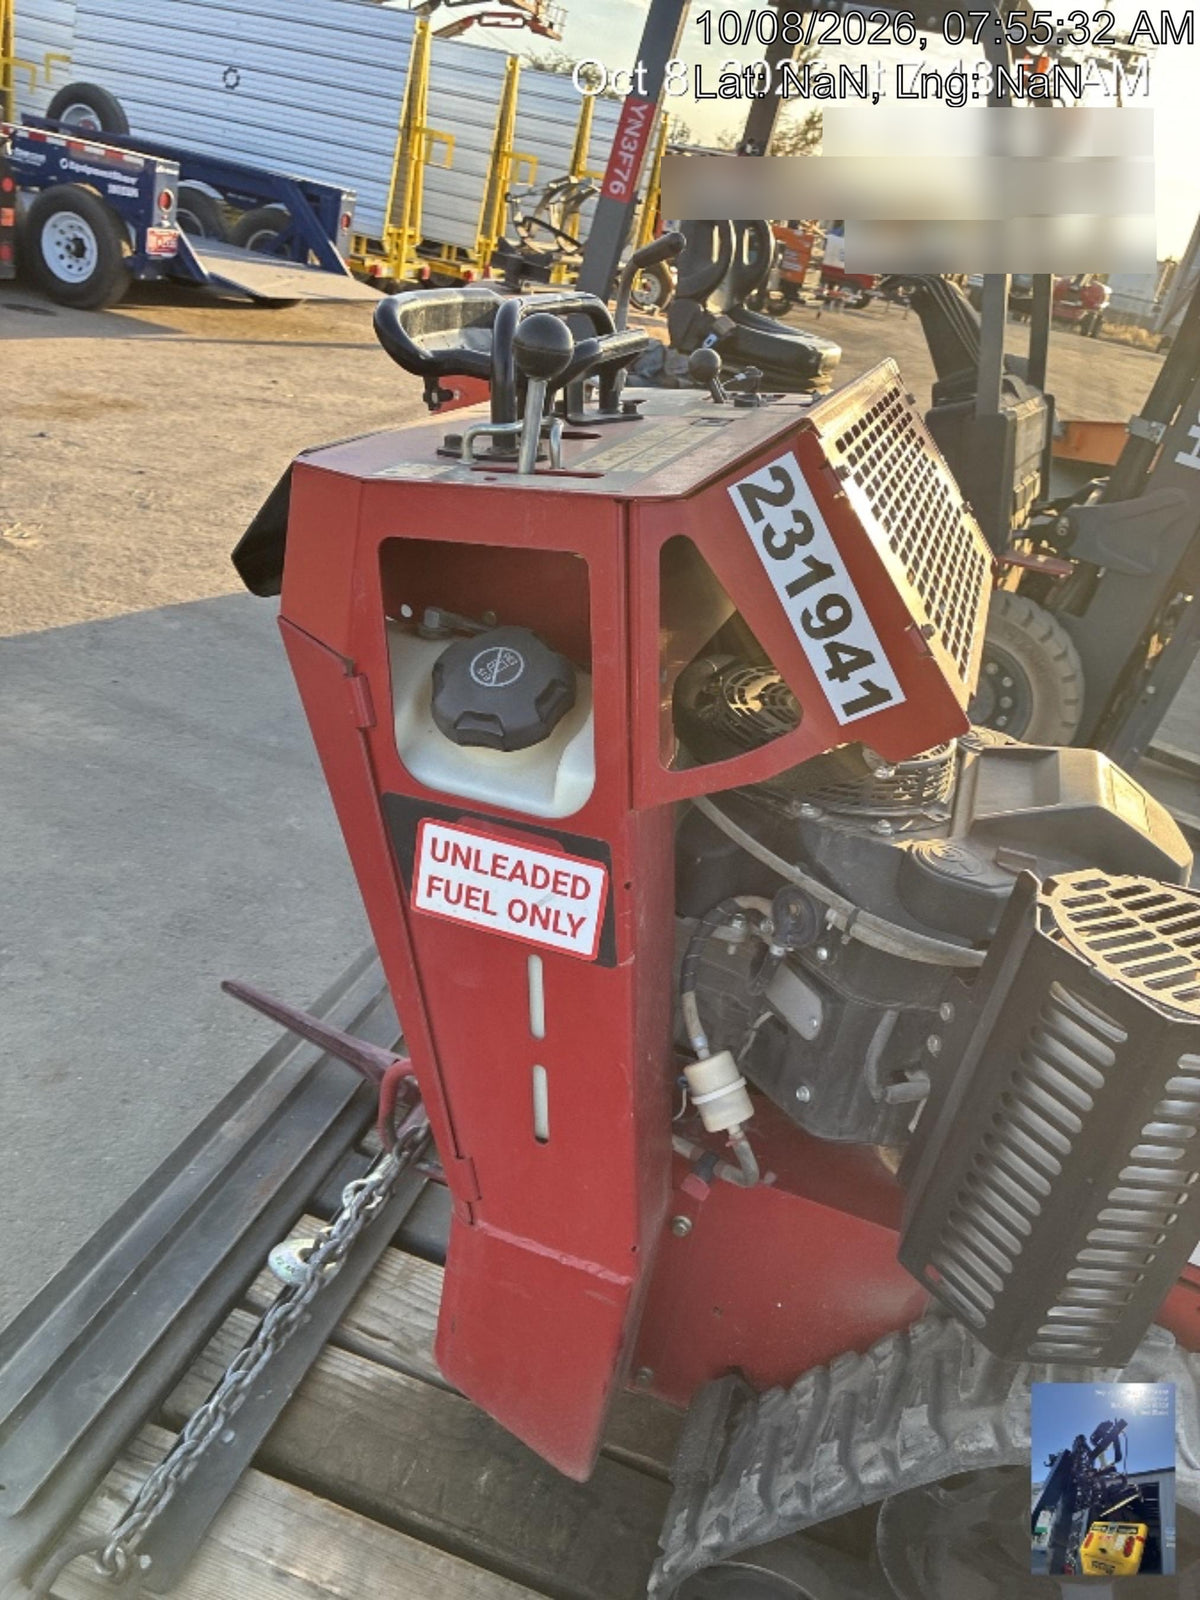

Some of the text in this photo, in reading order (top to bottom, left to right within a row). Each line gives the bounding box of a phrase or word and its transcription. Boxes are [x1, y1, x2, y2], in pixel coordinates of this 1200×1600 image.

[608, 103, 649, 195] YN3F76
[736, 464, 894, 717] 231941
[425, 873, 587, 940] FUEL ONLY
[430, 836, 592, 901] UNLEADED
